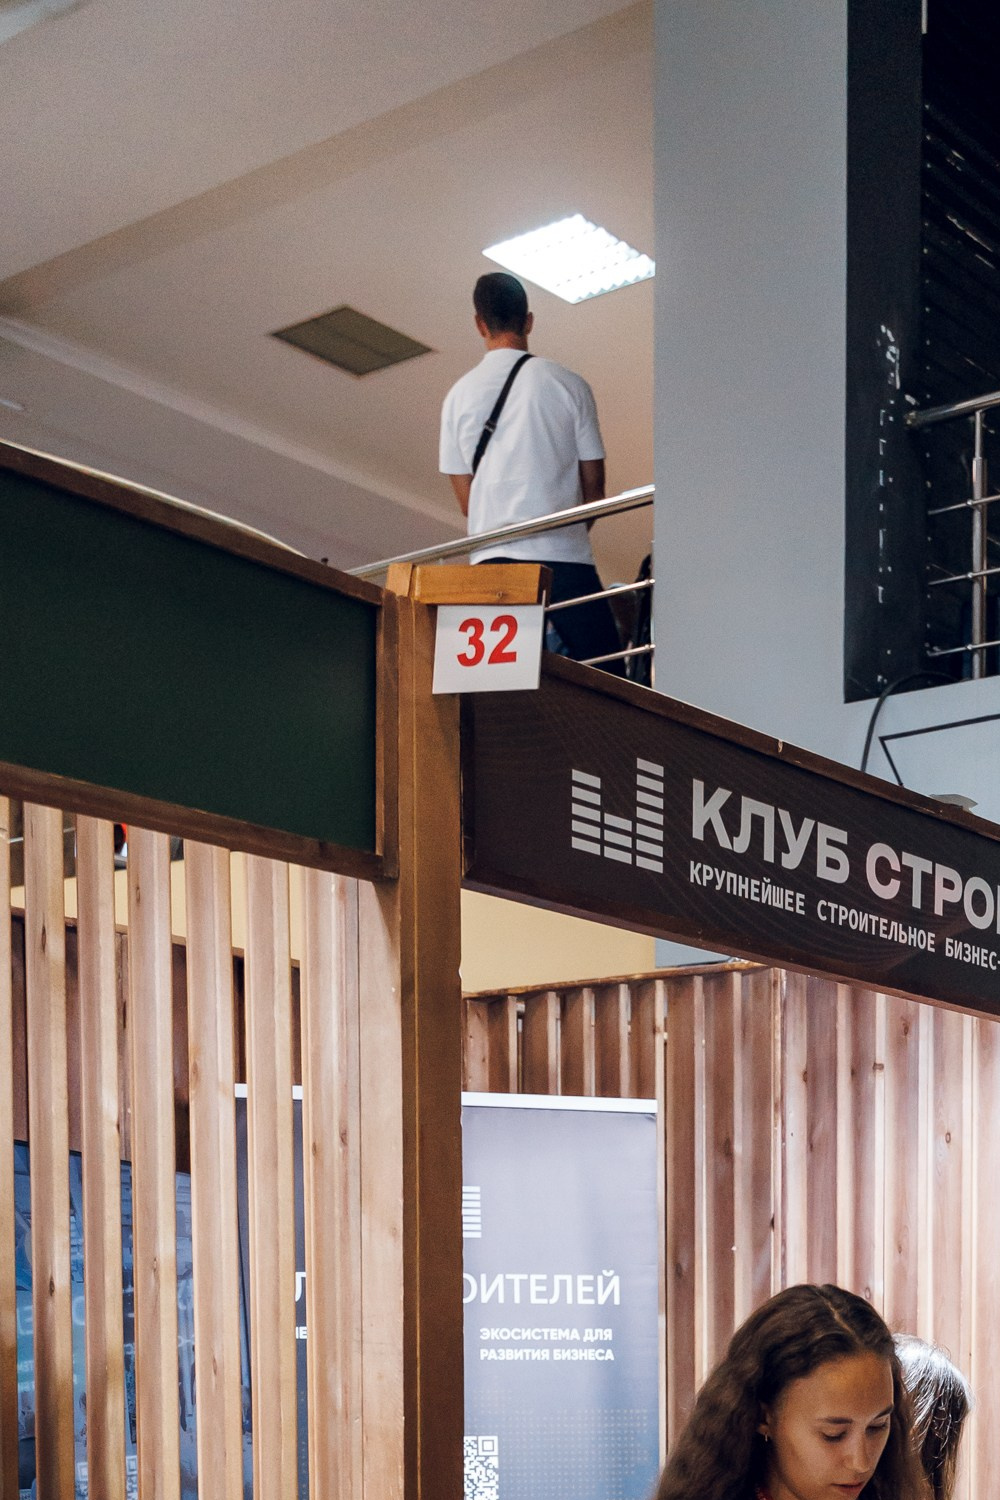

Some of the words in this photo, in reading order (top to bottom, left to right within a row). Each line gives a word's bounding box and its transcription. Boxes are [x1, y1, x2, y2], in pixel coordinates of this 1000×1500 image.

[457, 614, 518, 668] 32
[692, 778, 850, 884] КЛУБ
[689, 860, 806, 915] КРУПНЕЙШЕЕ
[817, 899, 936, 953] СТРОИТЕЛЬНОЕ
[463, 1269, 621, 1305] ОИТЕЛЕЙ
[480, 1328, 580, 1341] ЭКОСИСТЕМА
[583, 1328, 613, 1342] ДЛЯ
[480, 1349, 550, 1361] РАЗВИТИЯ
[553, 1349, 615, 1361] БИЗНЕСА
